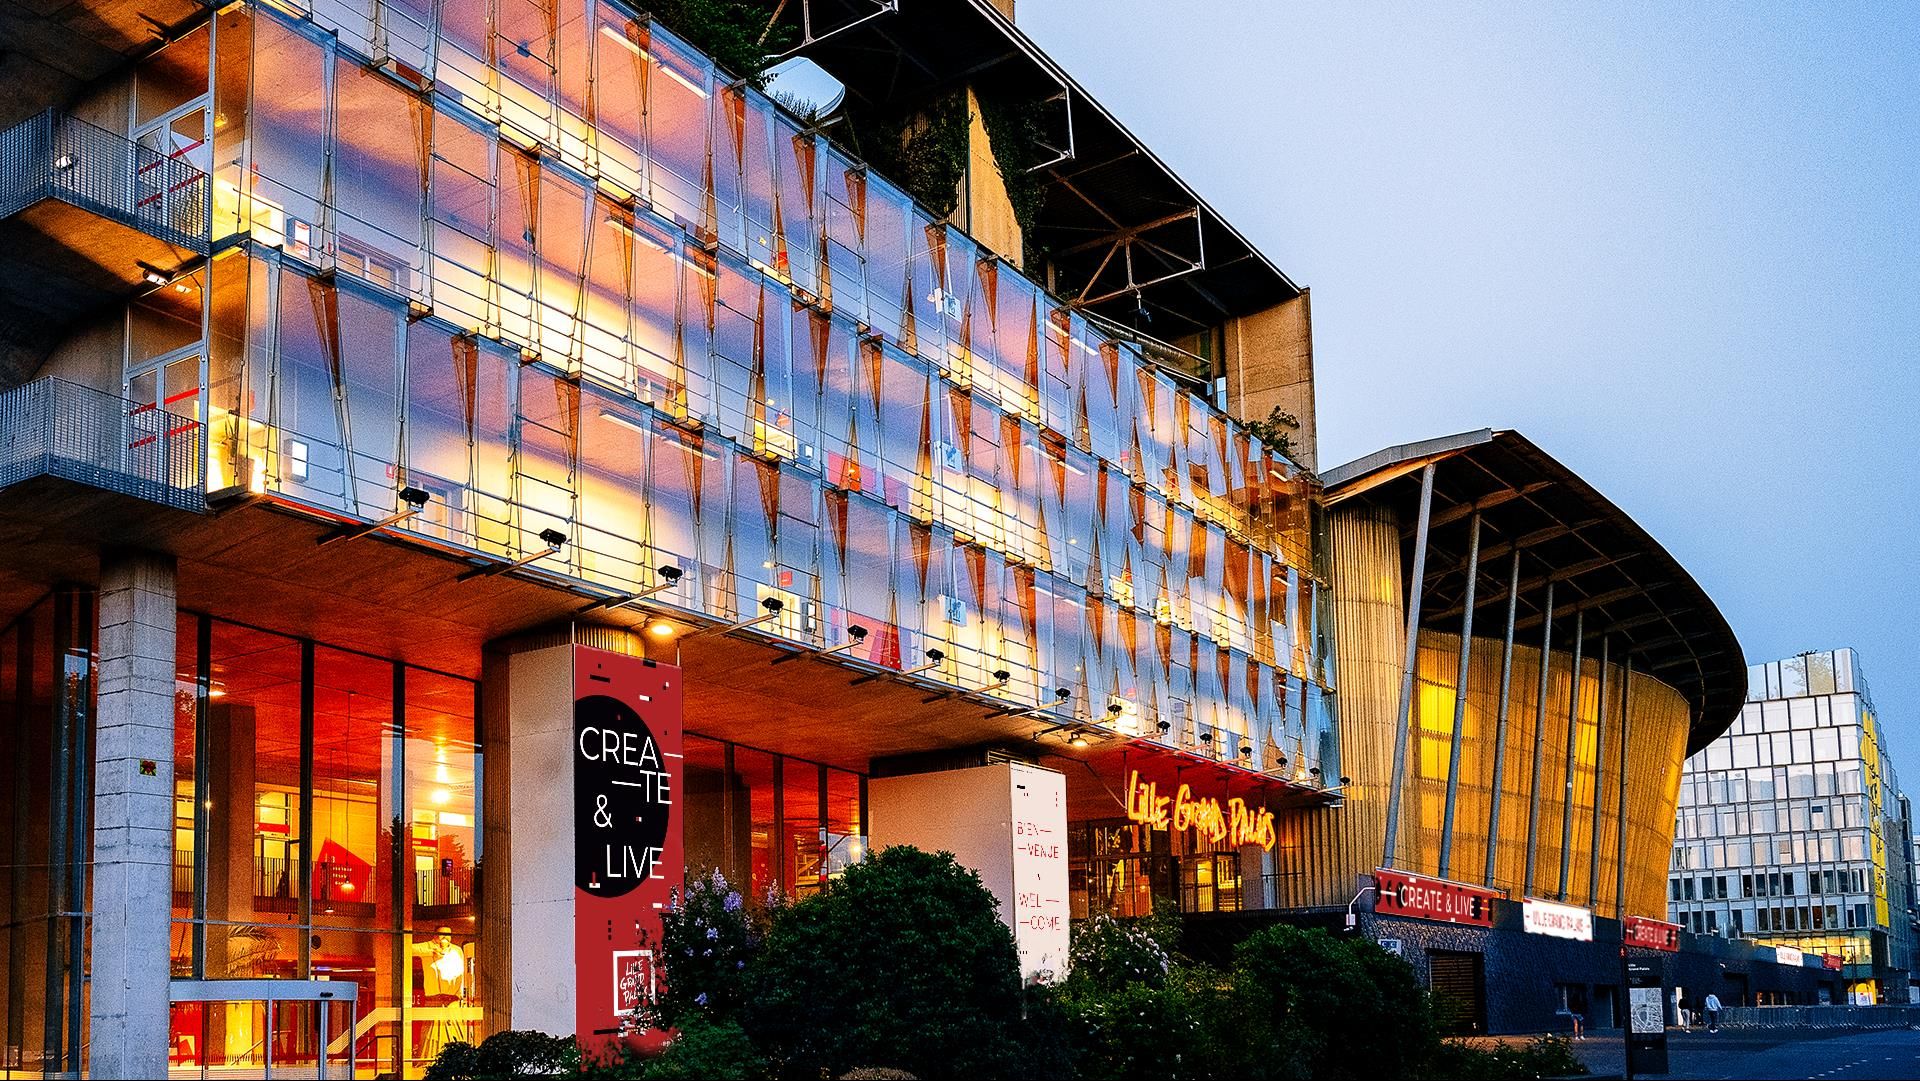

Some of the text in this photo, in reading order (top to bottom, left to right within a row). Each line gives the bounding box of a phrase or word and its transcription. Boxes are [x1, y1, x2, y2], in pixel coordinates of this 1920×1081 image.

[593, 794, 613, 828] &
[606, 844, 665, 880] LIVE
[1400, 884, 1475, 917] CREATE & LIVE
